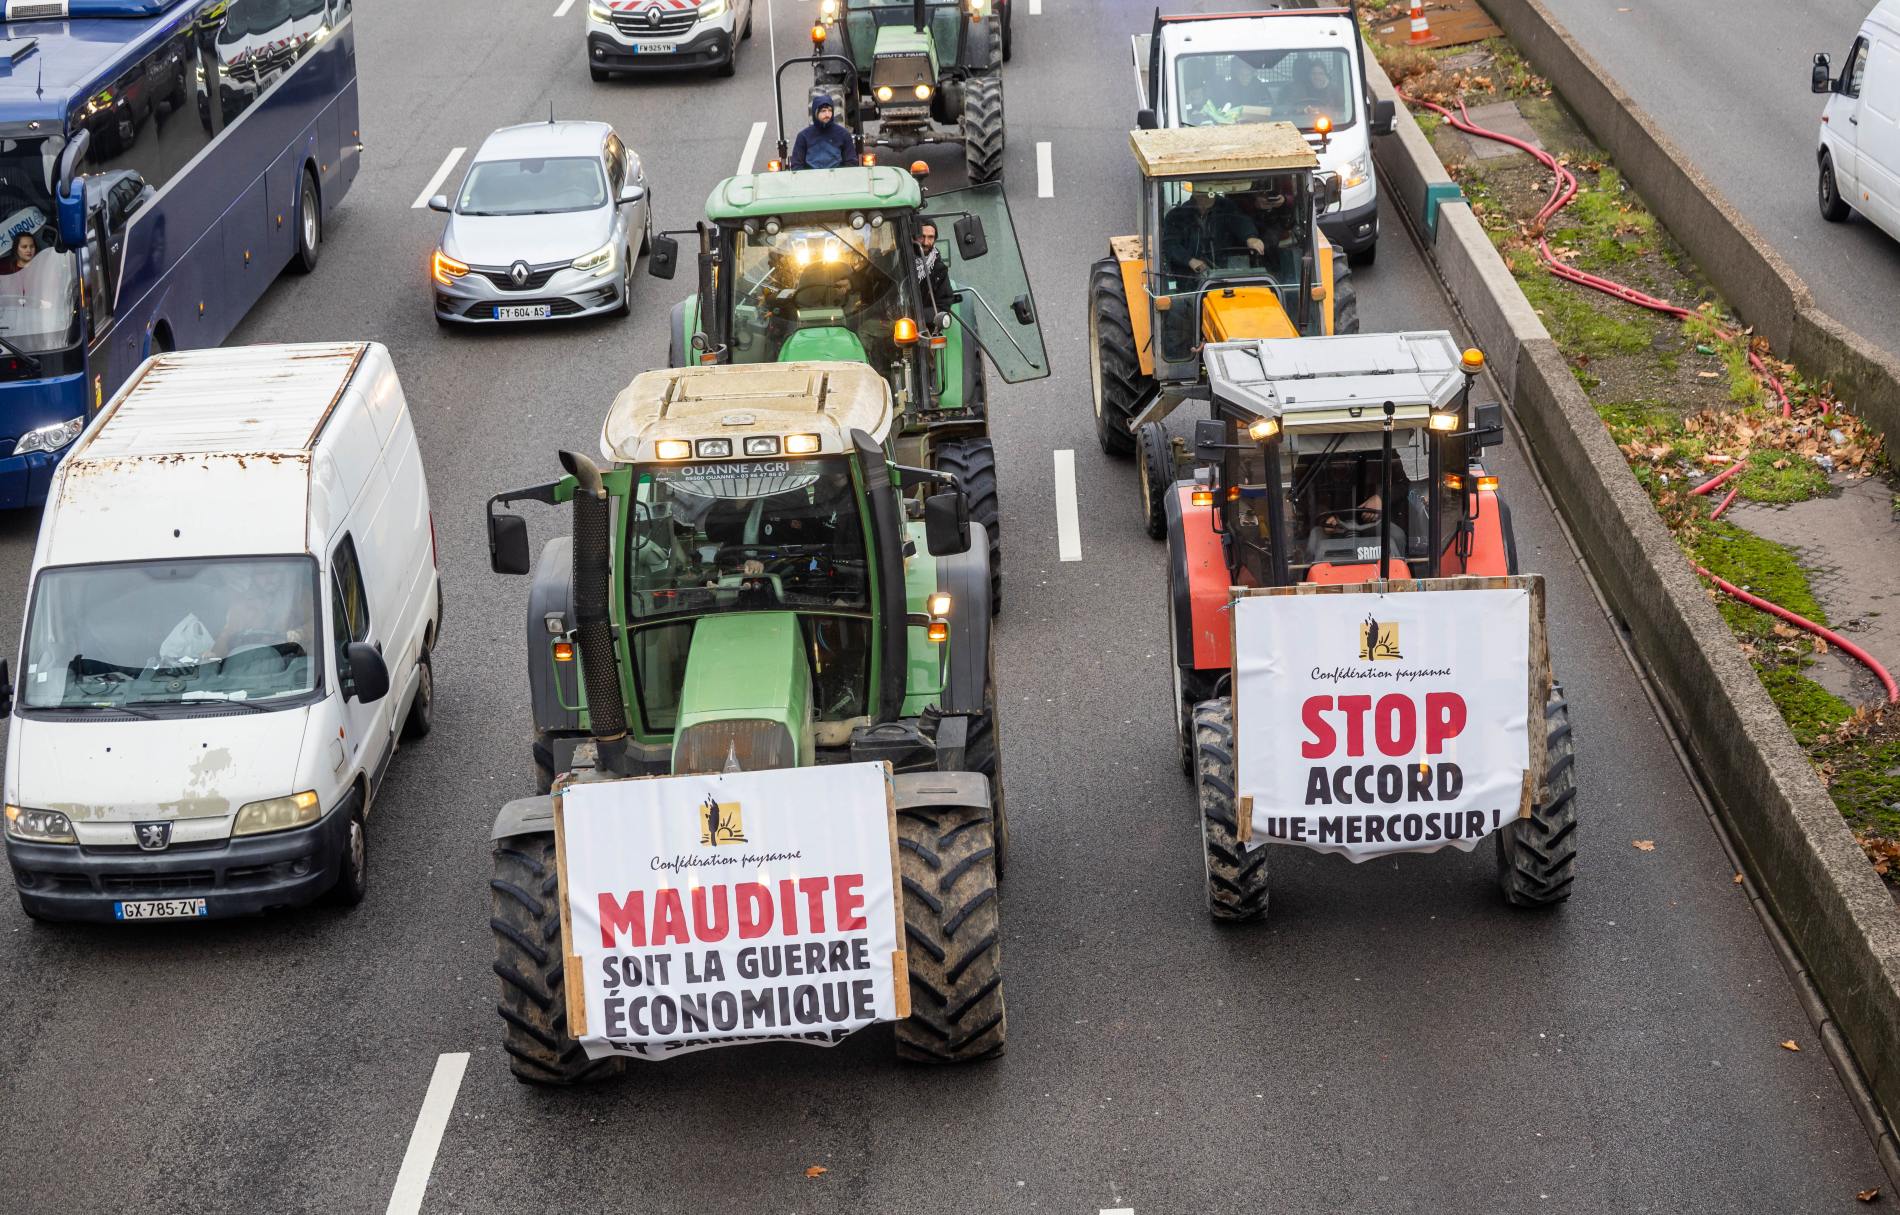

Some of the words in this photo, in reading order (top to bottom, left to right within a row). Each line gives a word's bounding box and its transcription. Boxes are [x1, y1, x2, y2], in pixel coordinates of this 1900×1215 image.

[500, 307, 544, 318] FY-604-AS
[681, 464, 750, 476] OUANNE
[753, 461, 790, 473] AGRI
[1357, 546, 1382, 560] SAM
[1310, 667, 1393, 684] Confédération
[1396, 667, 1451, 682] paysanne
[1302, 692, 1467, 759] STOP
[1305, 763, 1464, 805] ACCORD
[650, 855, 738, 874] Confédération
[742, 850, 802, 868] paysanne
[124, 901, 196, 917] GX-785-ZV
[598, 873, 868, 949] MAUDITE
[603, 953, 672, 989] SOIT
[685, 949, 726, 984] LA
[737, 937, 871, 980] GUERRE
[604, 979, 876, 1038] ÉCONOMIQUE
